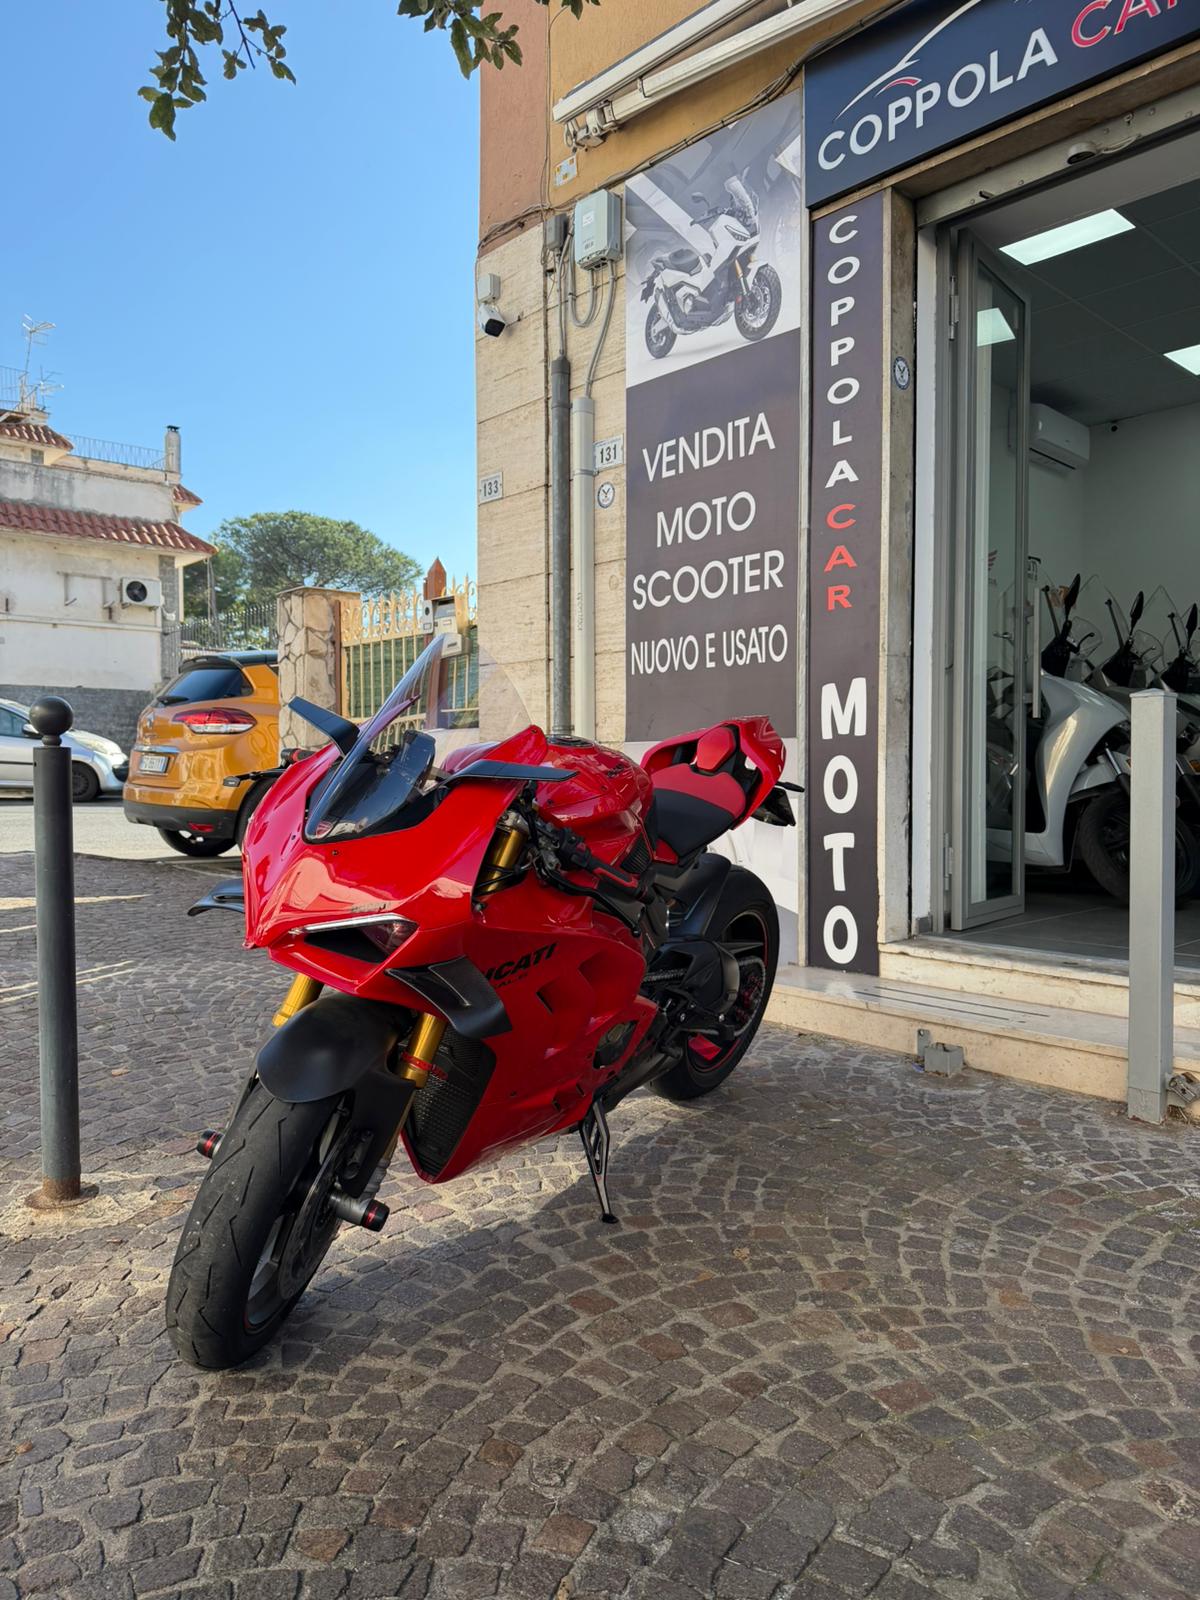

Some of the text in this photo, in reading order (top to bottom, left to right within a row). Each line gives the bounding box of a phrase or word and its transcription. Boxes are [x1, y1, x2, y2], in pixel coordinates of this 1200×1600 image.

[817, 0, 1178, 170] COPPOLA CA
[824, 214, 861, 611] COPPOLA CAR
[600, 444, 617, 464] 131
[642, 412, 776, 483] VENDITA
[483, 479, 499, 497] 133
[656, 491, 756, 548] MOTO
[632, 550, 785, 611] SCOOTER
[631, 624, 788, 676] NUOVO E USATO
[820, 676, 867, 965] MOTO
